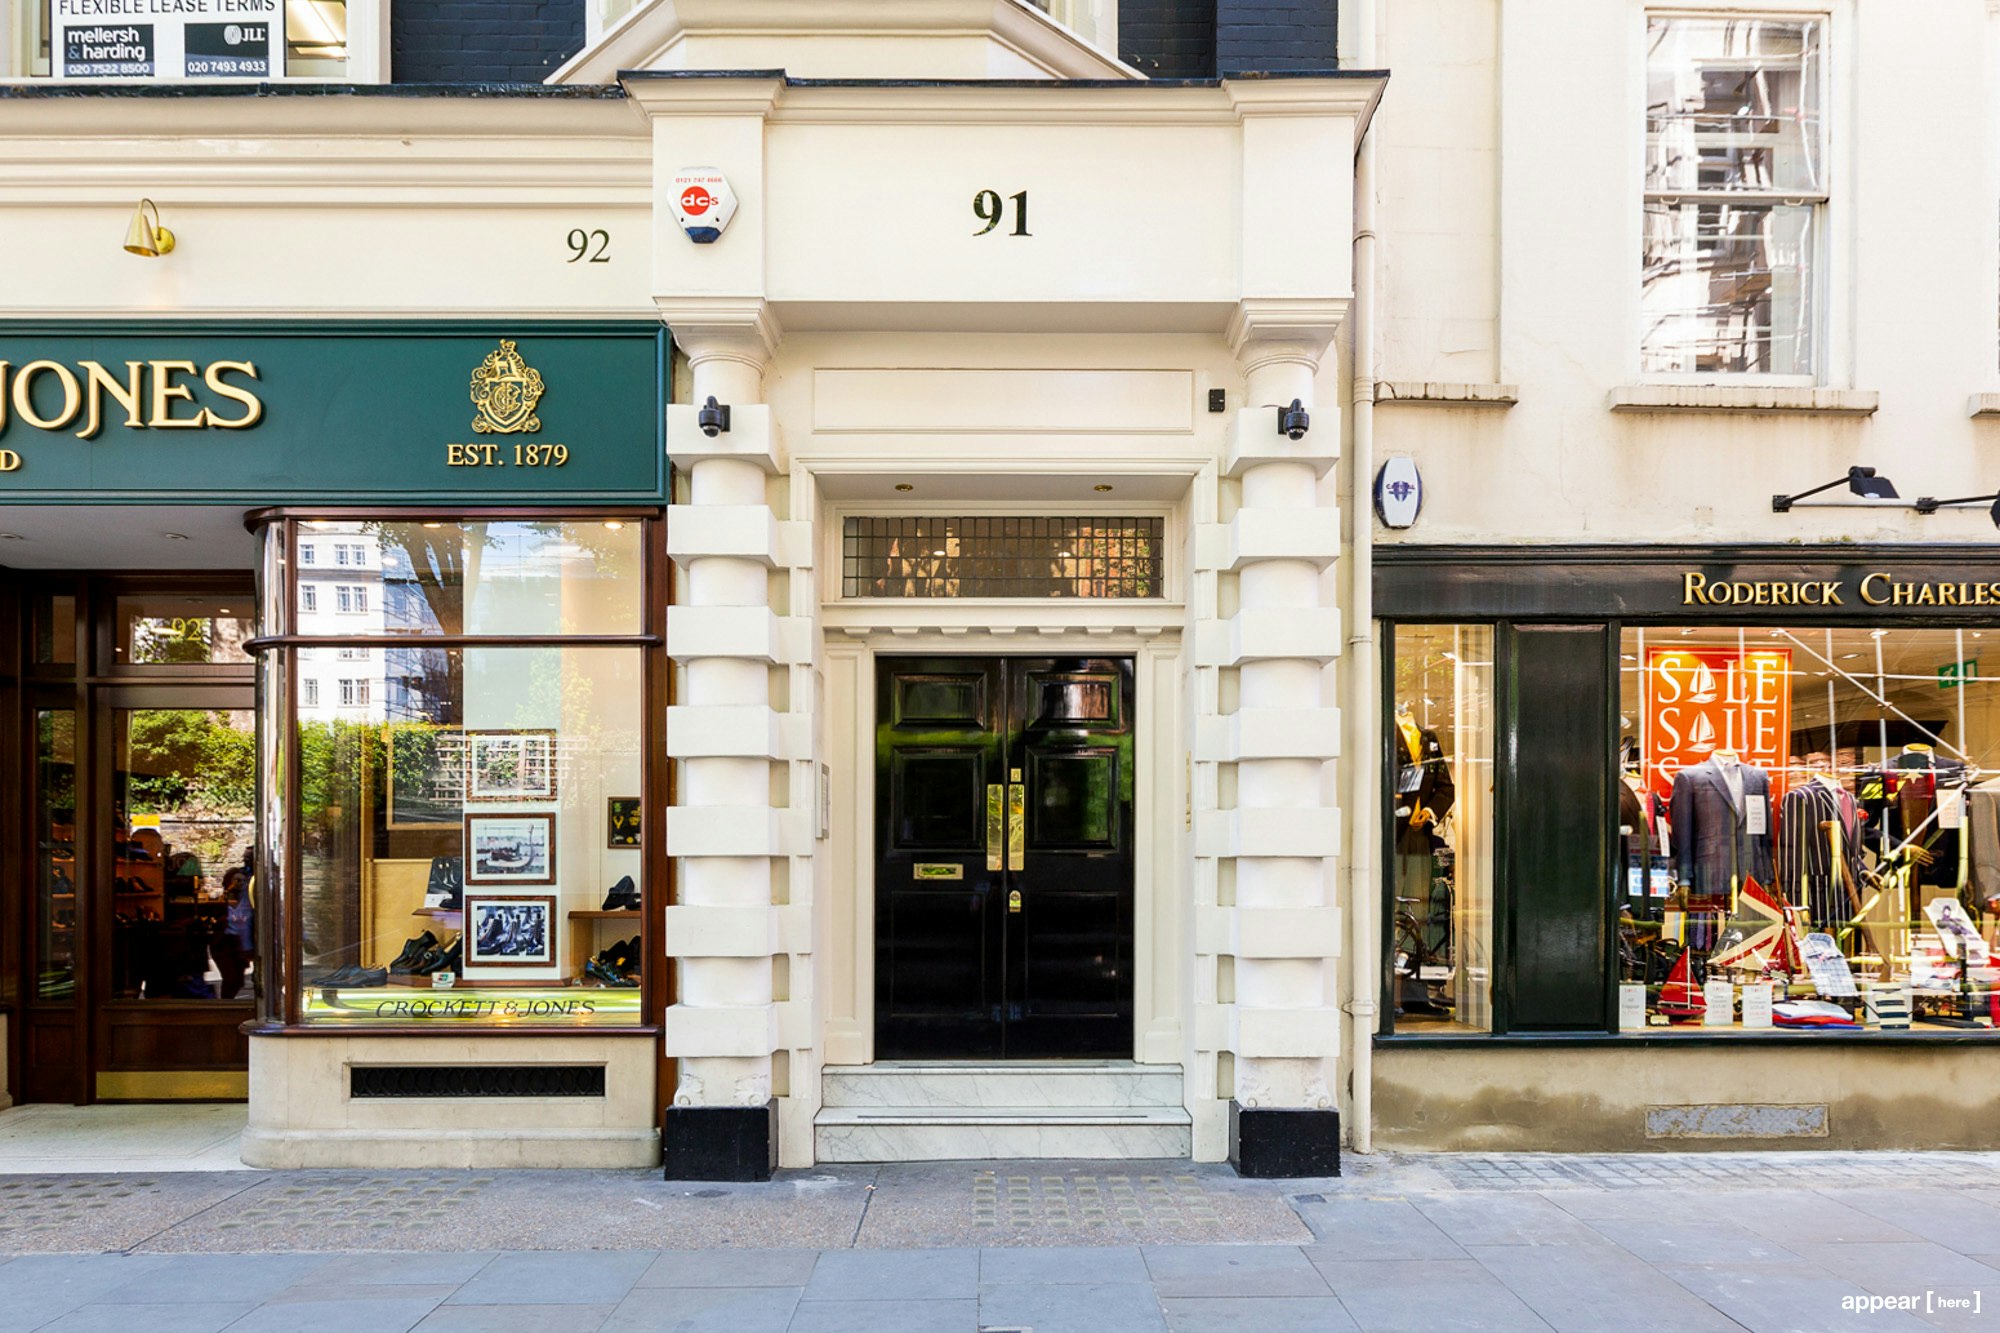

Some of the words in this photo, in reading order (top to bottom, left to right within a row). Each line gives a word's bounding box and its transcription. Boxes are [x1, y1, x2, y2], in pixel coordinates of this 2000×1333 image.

[59, 0, 144, 15] FLEXIBLE
[150, 0, 208, 13] LEASE
[215, 0, 276, 12] TERMS
[67, 26, 139, 44] mellersh
[68, 45, 80, 60] &
[83, 43, 146, 62] harding
[68, 63, 91, 75] 020
[91, 63, 119, 74] 7522
[120, 63, 150, 74] 8500
[187, 61, 209, 73] 020
[210, 61, 238, 73] 7493
[238, 60, 267, 73] 4933
[681, 193, 719, 207] dcs
[972, 189, 1033, 237] 91
[566, 228, 611, 263] 92
[446, 443, 505, 466] EST.
[513, 443, 569, 466] 1879
[1683, 572, 1845, 606] RODERICK
[1860, 572, 2000, 606] CHARLES
[171, 617, 203, 641] 92
[376, 998, 500, 1018] CROCKETT
[517, 1000, 596, 1018] JONES
